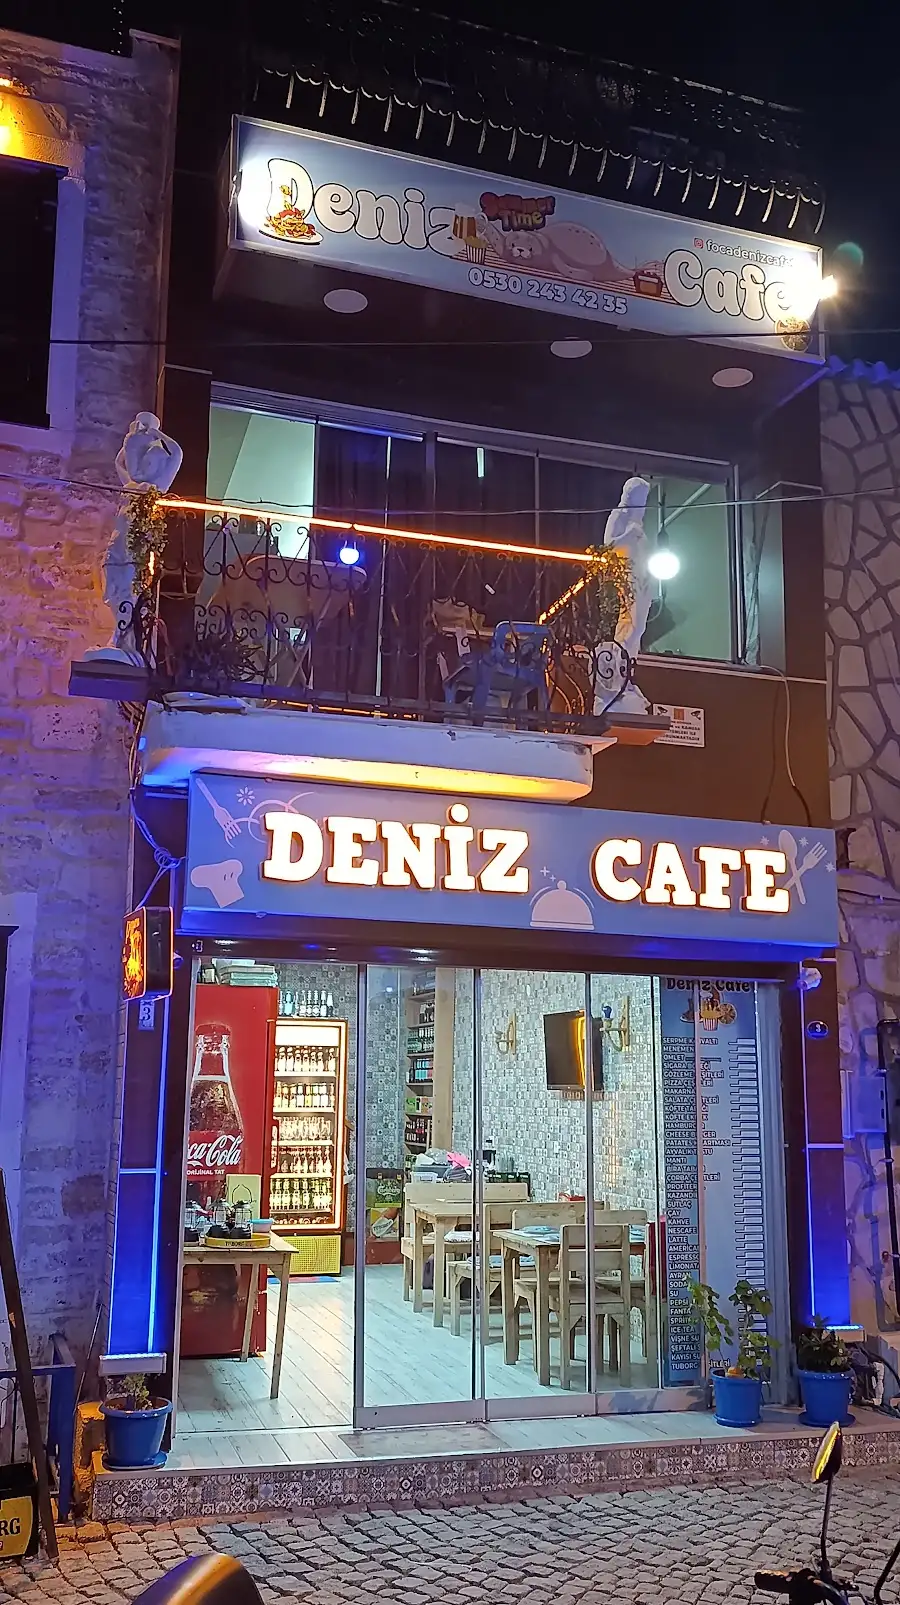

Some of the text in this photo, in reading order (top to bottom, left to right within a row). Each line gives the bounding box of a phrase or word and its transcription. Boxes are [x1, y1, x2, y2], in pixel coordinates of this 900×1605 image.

[267, 158, 465, 259] Deniz
[499, 210, 543, 229] Time
[468, 267, 628, 315] 0530 243 42 35
[664, 248, 803, 326] Cafe
[261, 803, 791, 914] DENİZ CAFE
[666, 977, 750, 992] Deniz Cafe
[142, 1007, 152, 1021] 3
[664, 1070, 693, 1078] GÖZLEME
[665, 1103, 686, 1112] KÖFTE
[187, 1135, 243, 1167] ca-Cola
[668, 1209, 680, 1218] ÇAY
[670, 1297, 689, 1306] PEPSİ
[670, 1316, 690, 1324] SPRİT
[672, 1362, 698, 1370] TUBORG
